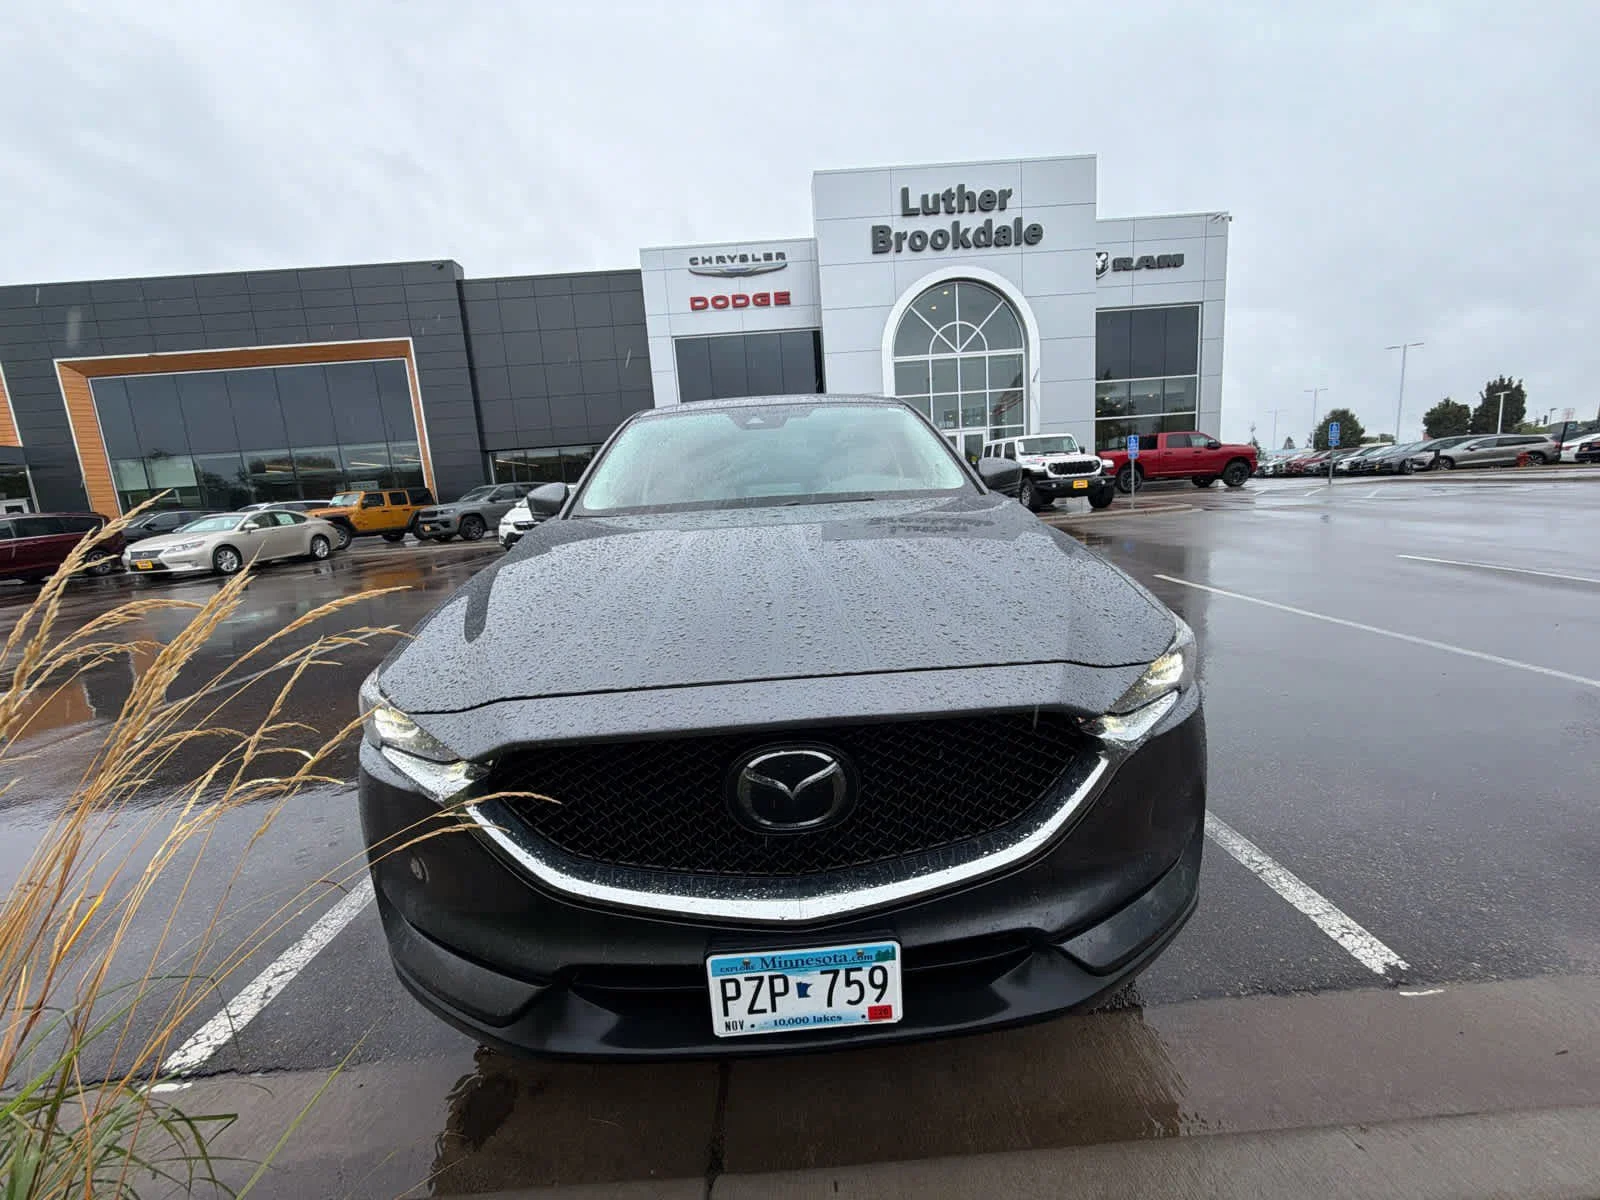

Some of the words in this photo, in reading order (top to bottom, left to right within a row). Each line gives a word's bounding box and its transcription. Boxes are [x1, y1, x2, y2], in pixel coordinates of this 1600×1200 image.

[901, 184, 1012, 216] Luther
[872, 217, 1043, 254] Brookdale
[689, 252, 787, 265] CHRYSLER
[1112, 254, 1184, 272] RAM
[690, 291, 791, 311] DODGE
[720, 974, 789, 1017] PZP
[820, 965, 888, 1008] 759
[725, 1020, 744, 1032] NOV
[774, 1015, 809, 1027] 10,000
[813, 1014, 842, 1024] lakes
